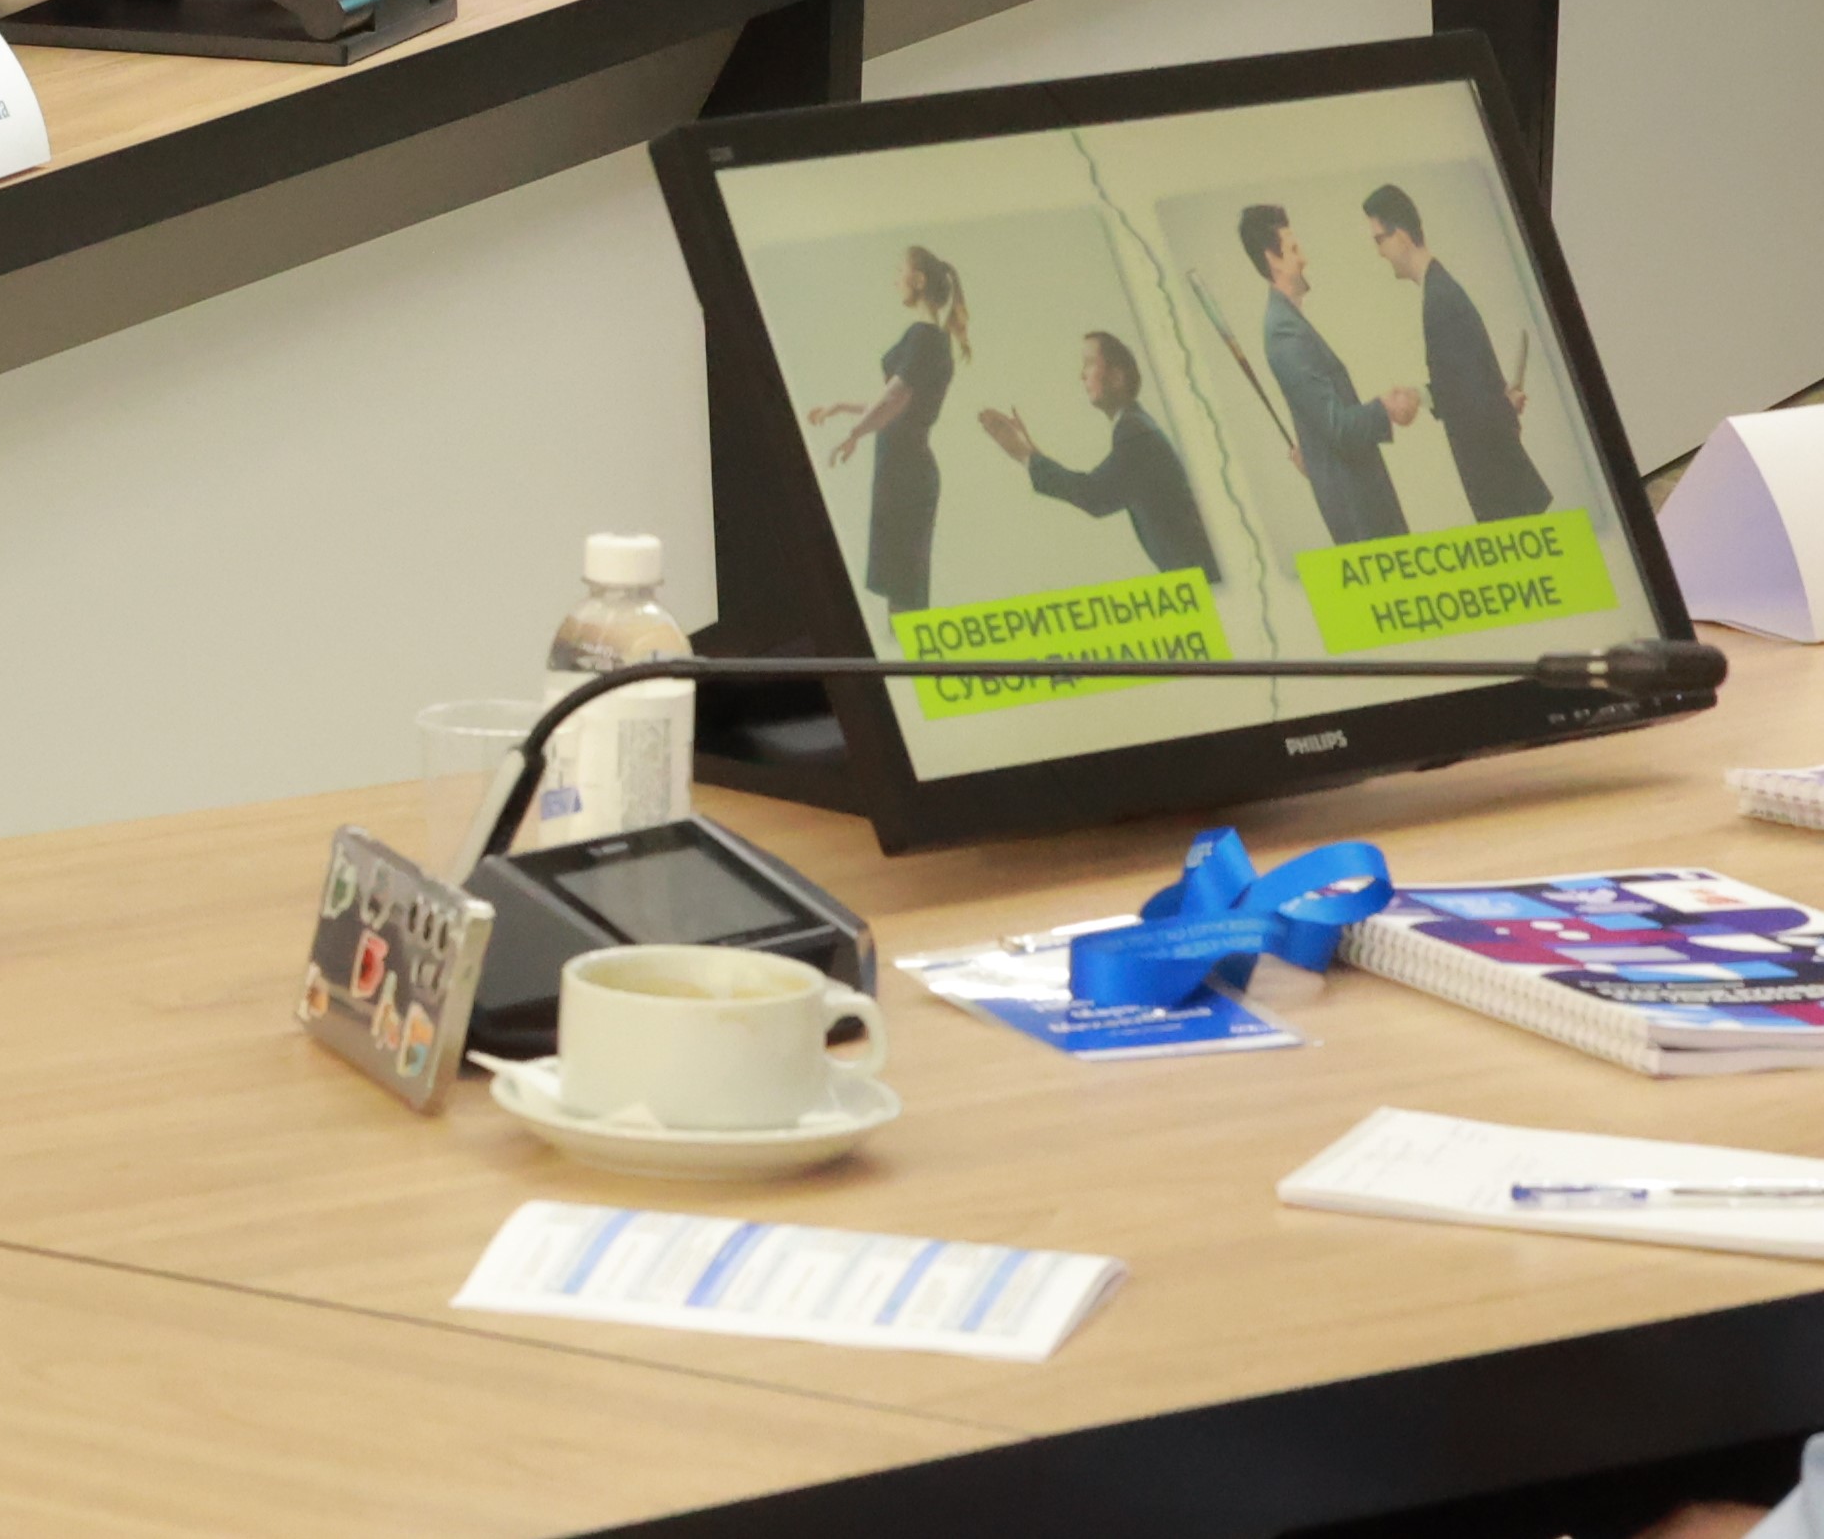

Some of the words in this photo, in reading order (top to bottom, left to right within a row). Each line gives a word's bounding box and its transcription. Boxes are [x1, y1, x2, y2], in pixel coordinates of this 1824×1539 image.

[1340, 526, 1564, 588] АГРЕССИВНОЕ
[913, 582, 1200, 660] ДОВЕРИТЕЛЬНАЯ
[1370, 575, 1562, 633] НЕДОВЕРИЕ
[1285, 729, 1348, 756] PHILIPS
